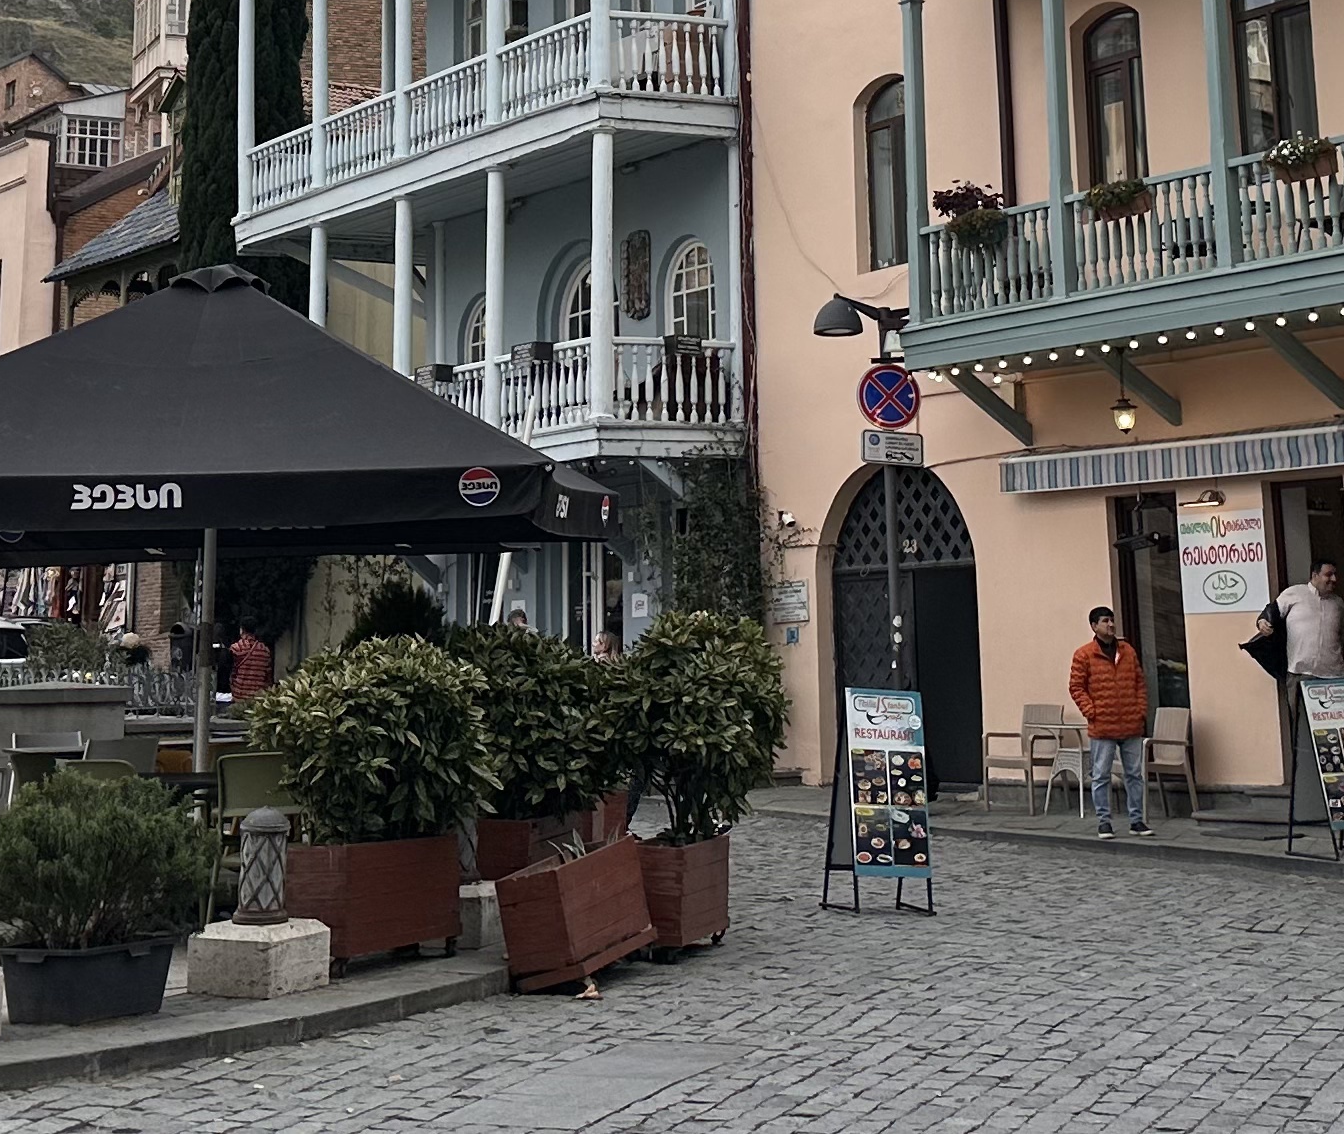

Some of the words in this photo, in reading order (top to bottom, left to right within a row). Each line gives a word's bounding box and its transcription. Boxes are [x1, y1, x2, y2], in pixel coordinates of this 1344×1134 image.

[902, 539, 917, 554] 23
[1182, 541, 1263, 566] რესტორანი
[1211, 574, 1239, 591] حلال
[854, 727, 916, 742] RESTAURANT
